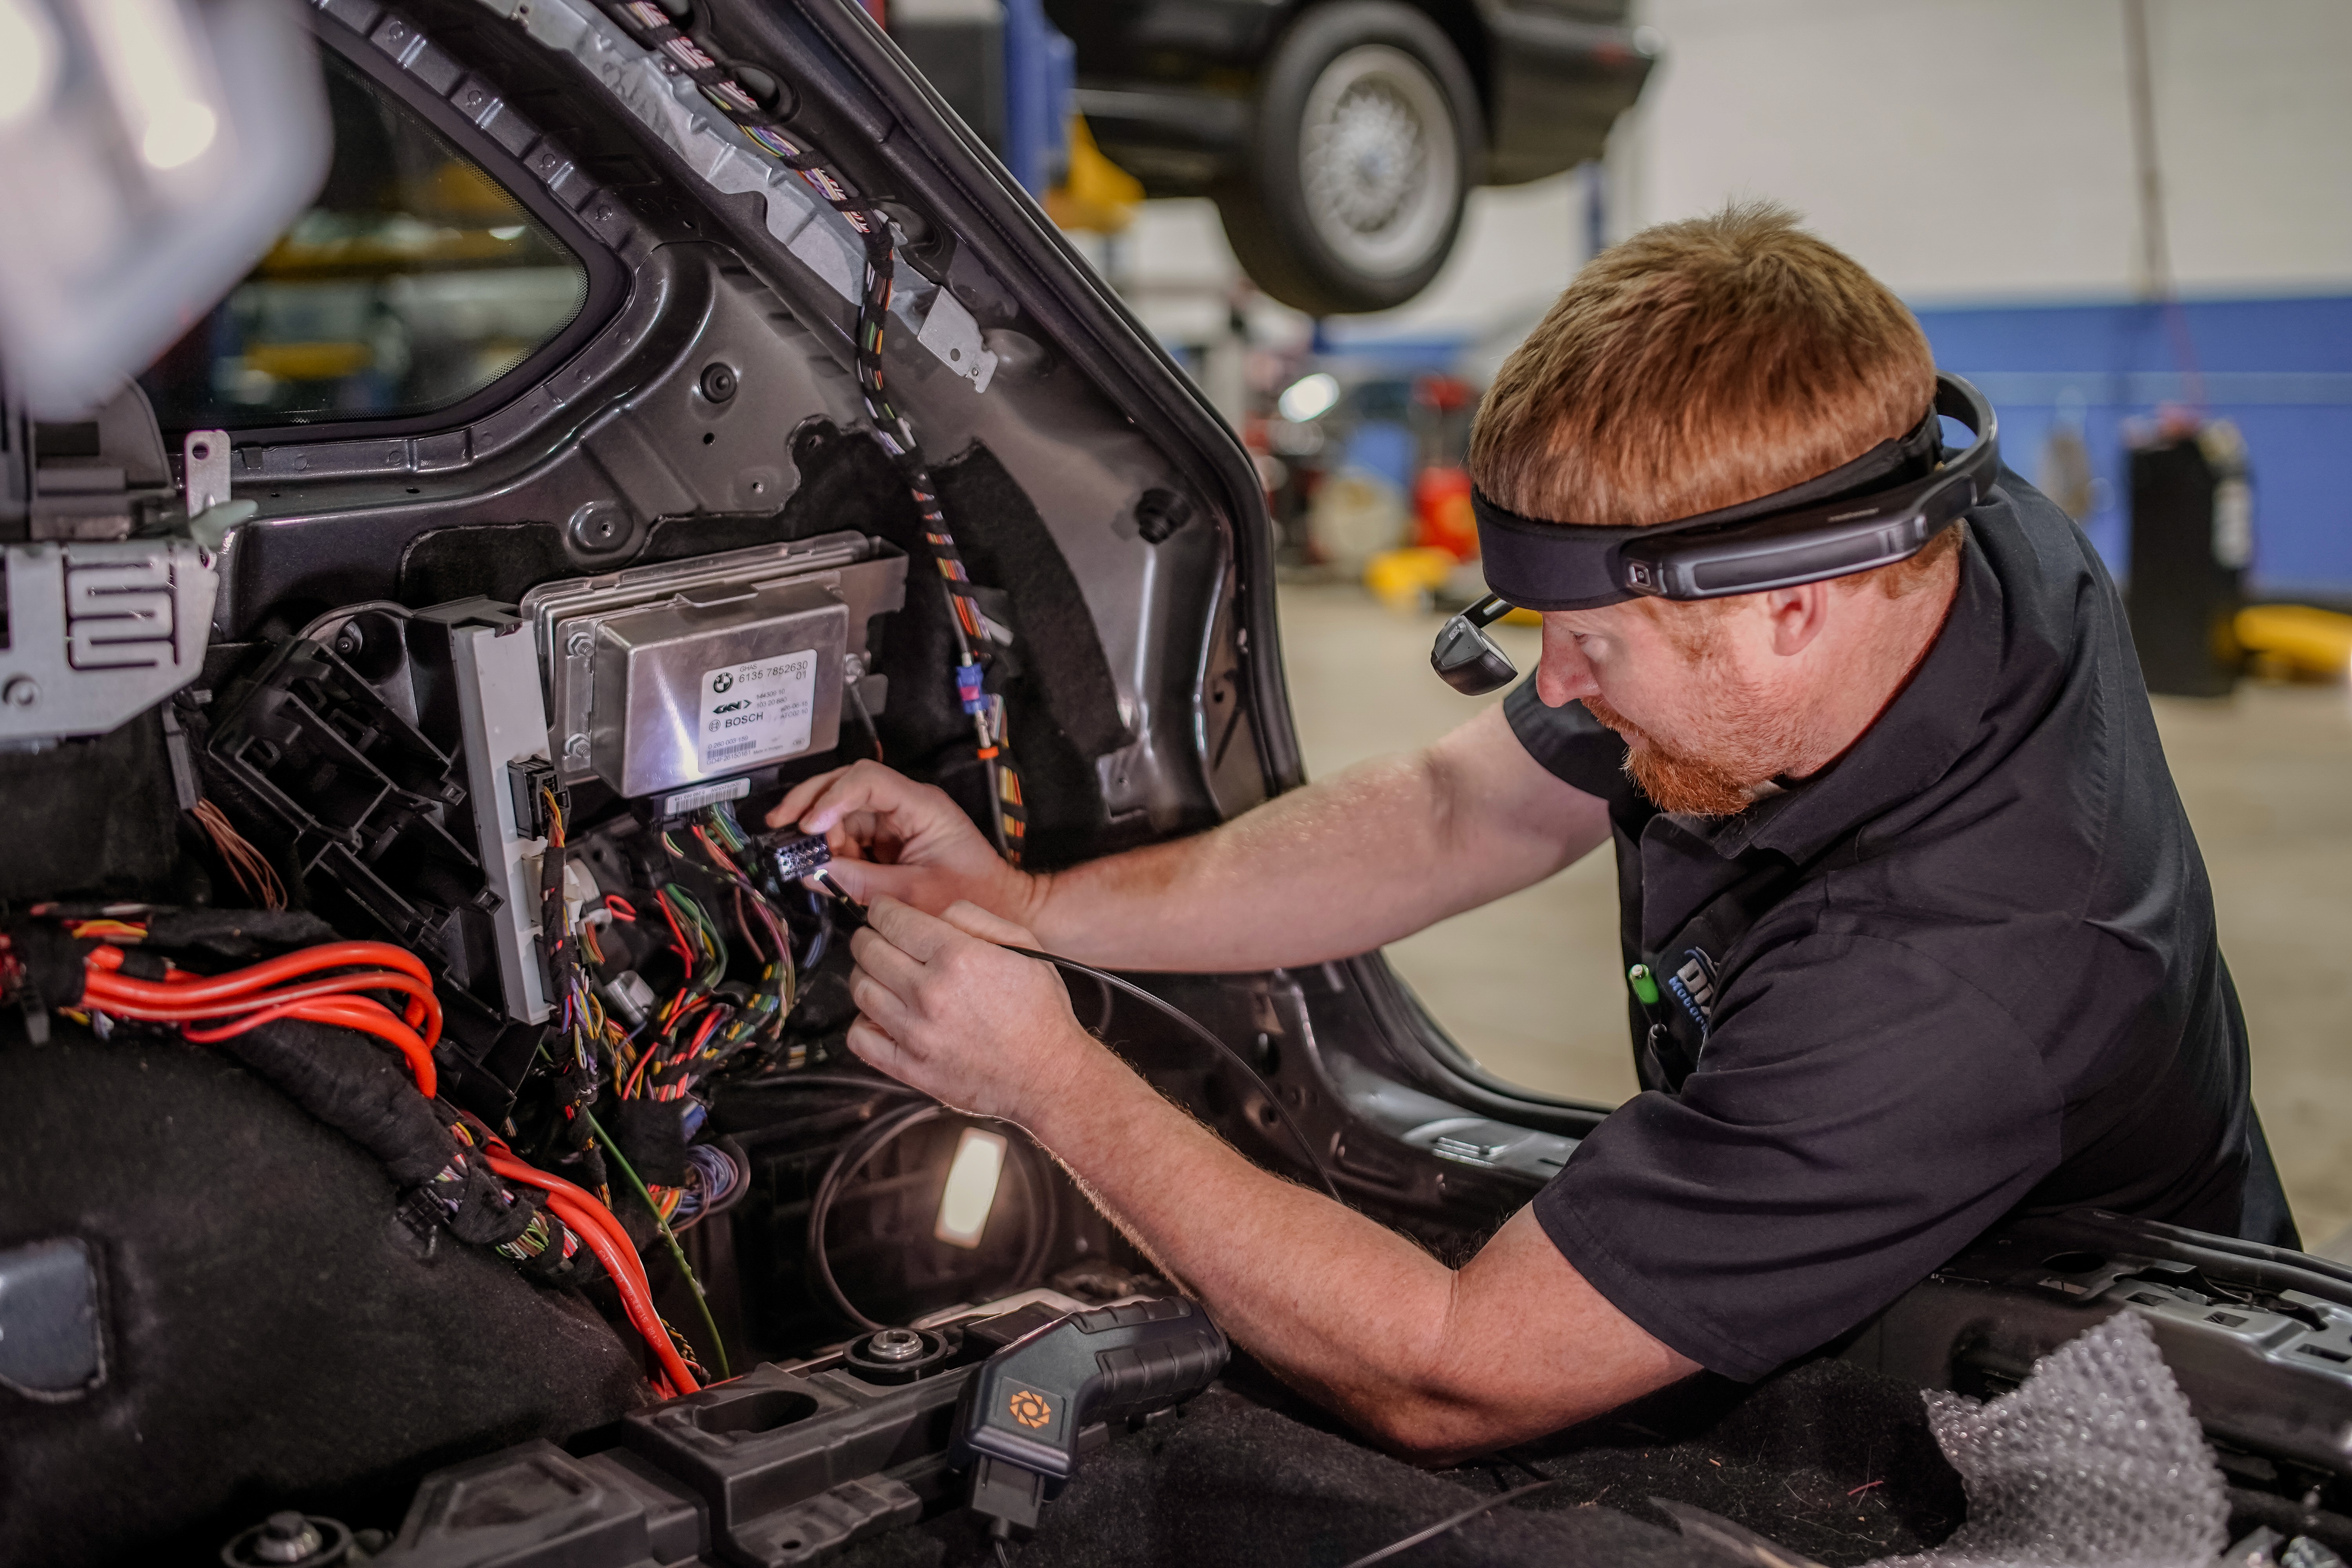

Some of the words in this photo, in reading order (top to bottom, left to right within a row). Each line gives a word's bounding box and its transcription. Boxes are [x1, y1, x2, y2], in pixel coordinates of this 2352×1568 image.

[739, 670, 763, 683] 6135
[767, 661, 808, 677] 7852630
[740, 663, 757, 672] GHAS
[796, 670, 806, 680] 01
[726, 711, 763, 728] BOSCH
